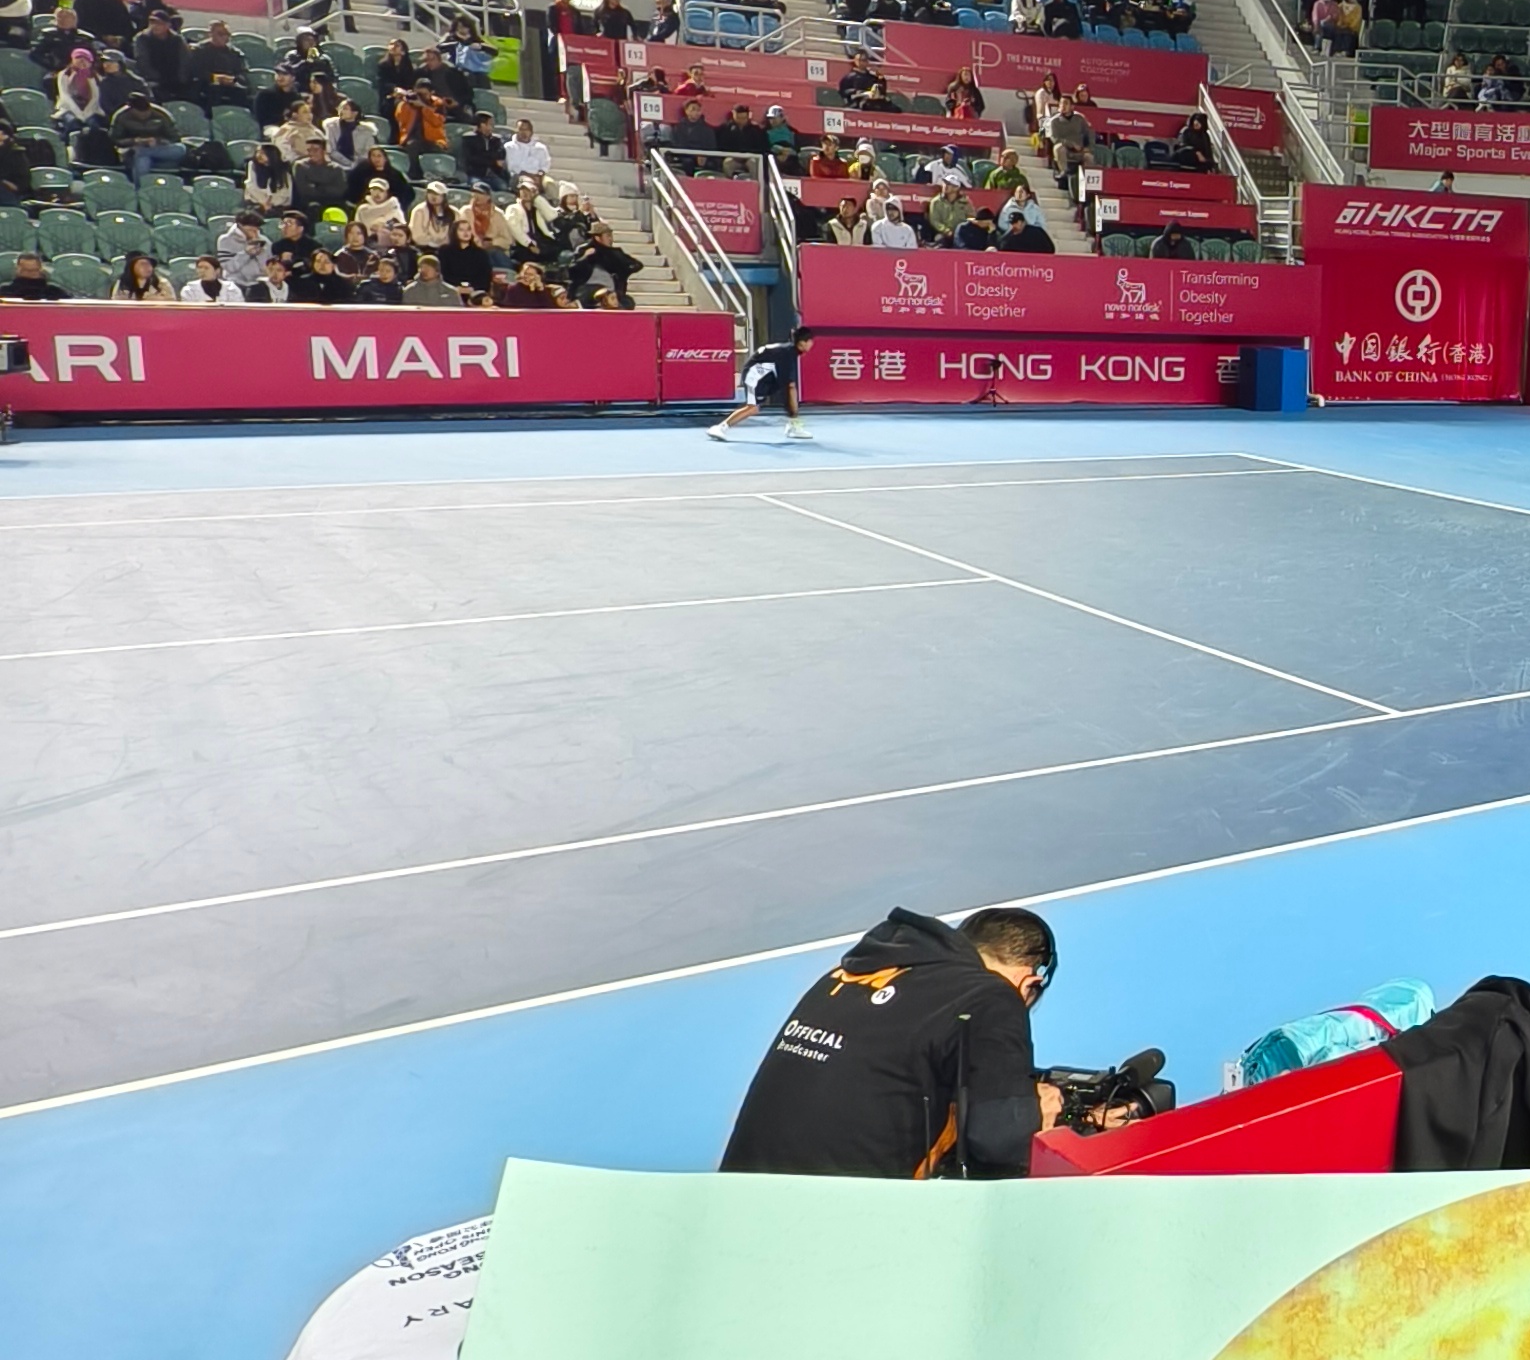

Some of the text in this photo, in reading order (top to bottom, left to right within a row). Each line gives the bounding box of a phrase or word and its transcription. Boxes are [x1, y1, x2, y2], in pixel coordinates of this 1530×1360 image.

[1409, 142, 1452, 159] Major
[1457, 144, 1506, 161] Sports
[1363, 203, 1504, 233] HKCTA
[965, 261, 1054, 281] Transforming
[1180, 270, 1259, 289] Transforming
[965, 282, 1018, 300] Obesity
[1179, 290, 1227, 306] Obesity
[965, 302, 1026, 320] Together
[1179, 309, 1235, 326] Together
[311, 336, 520, 380] MARI
[677, 348, 732, 360] HKCTA
[829, 349, 907, 381] 香港
[939, 352, 1053, 382] HONG
[1080, 354, 1187, 383] KONG
[1335, 369, 1373, 382] BANK
[1375, 370, 1394, 382] OF
[1395, 371, 1438, 383] CHINA
[783, 1019, 844, 1049] OFFICIAL
